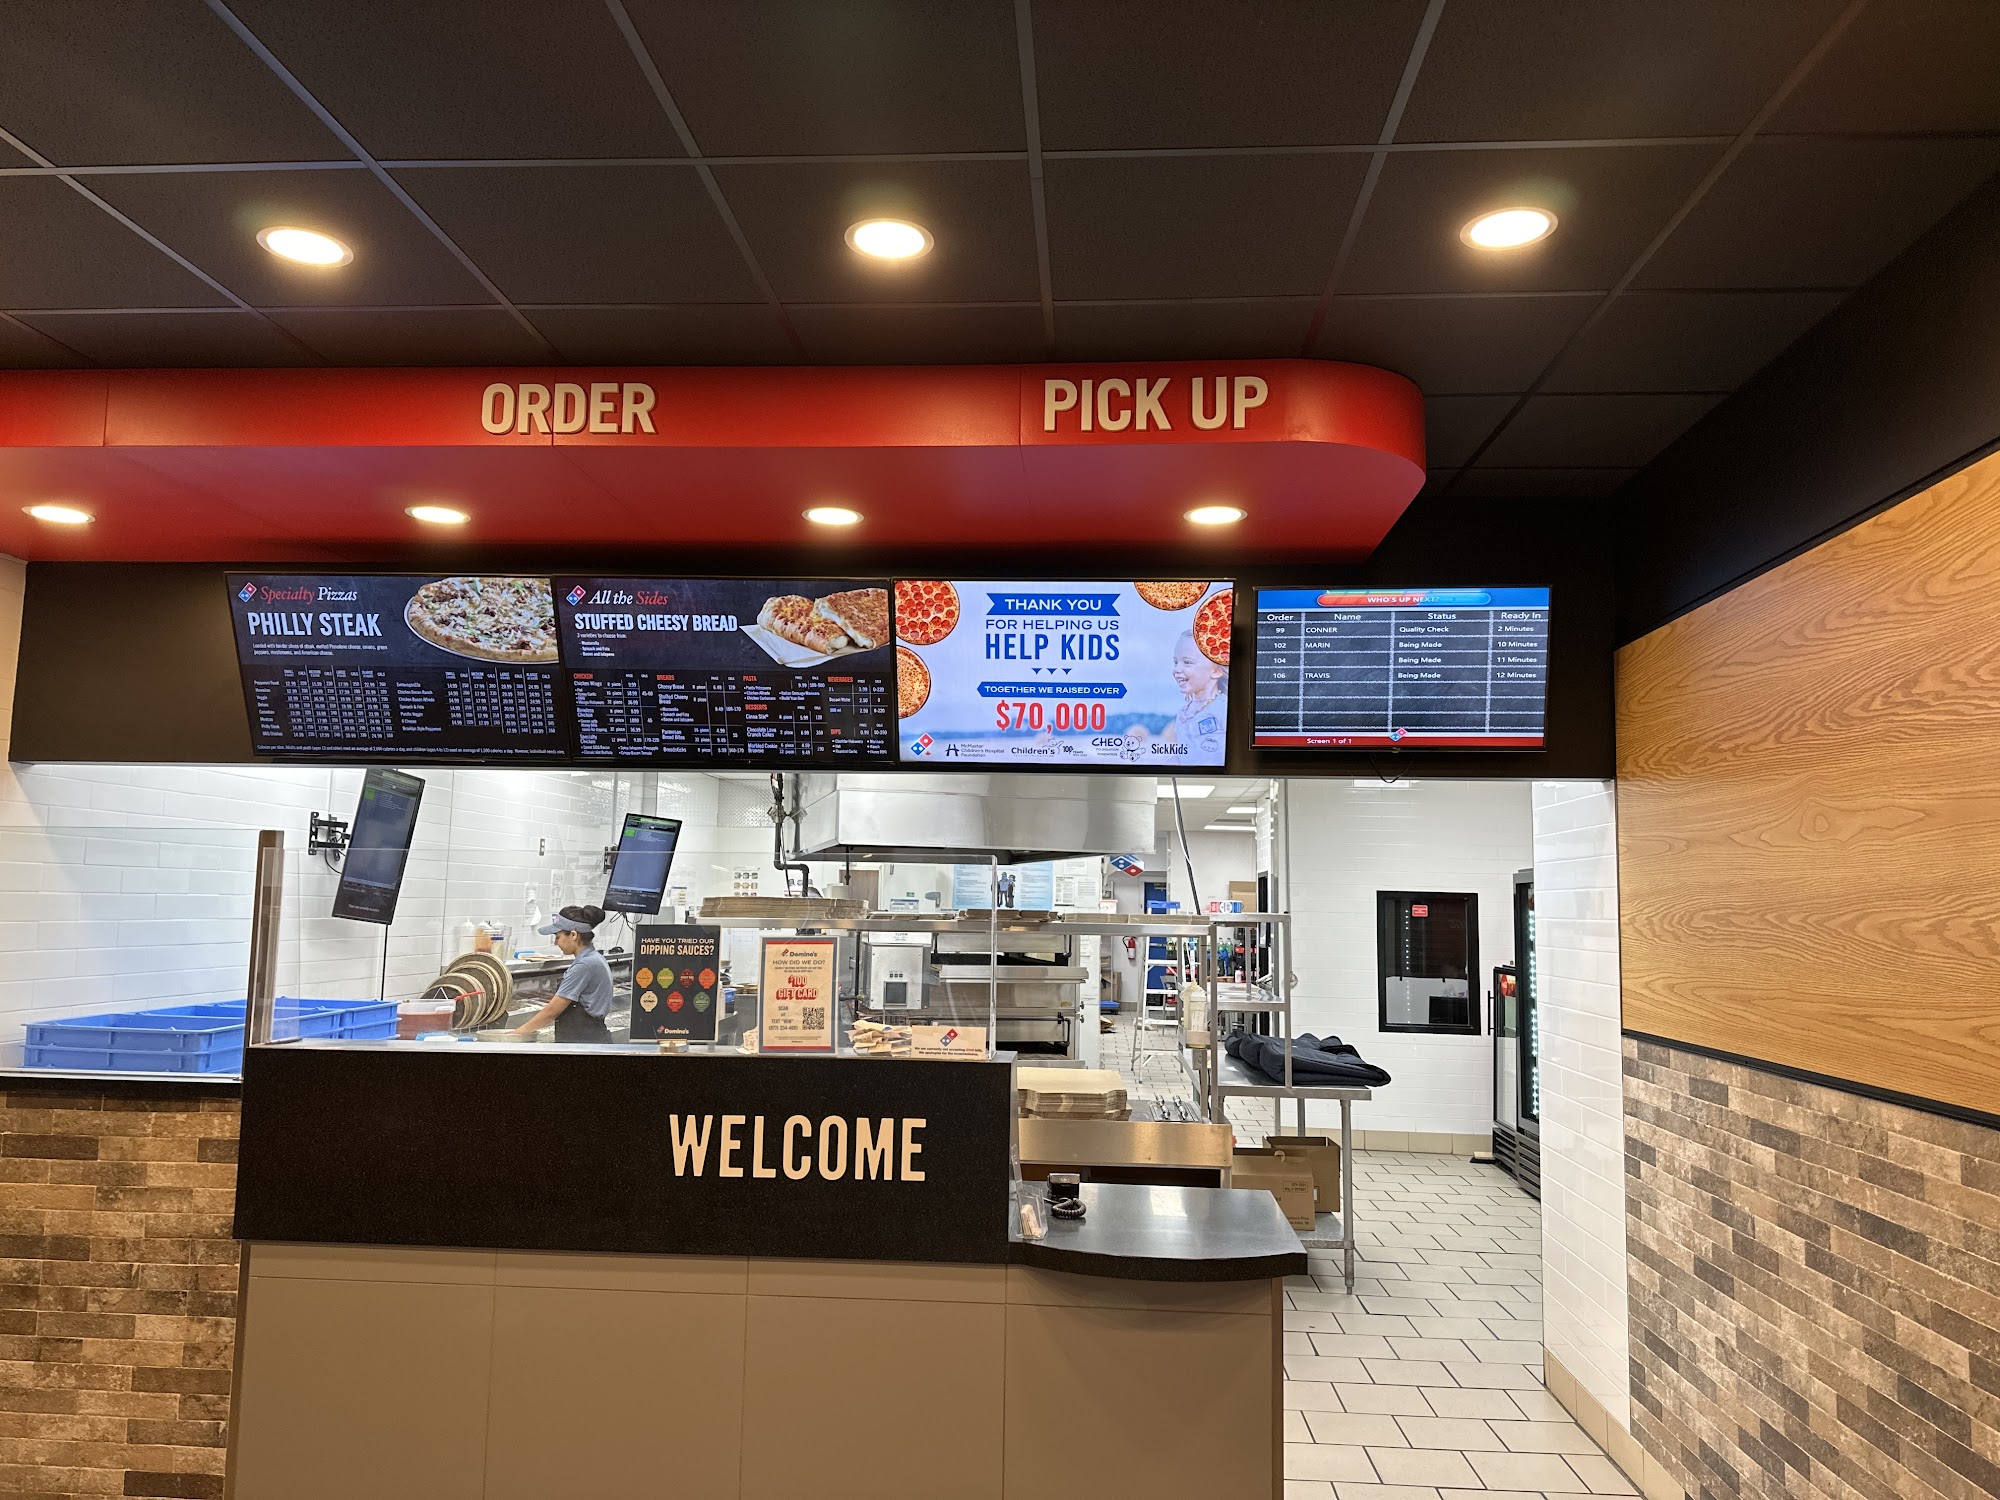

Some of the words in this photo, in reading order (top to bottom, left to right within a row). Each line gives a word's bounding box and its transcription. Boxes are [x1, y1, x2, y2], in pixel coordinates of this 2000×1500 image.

[479, 382, 657, 435] ORDER
[1043, 377, 1173, 432] PICK
[1190, 375, 1268, 429] UP
[260, 586, 314, 604] Specialty
[318, 587, 357, 600] Pizzas
[588, 591, 610, 604] All
[613, 591, 633, 605] the
[636, 591, 668, 605] Sides
[1005, 599, 1061, 611] THANK
[1066, 599, 1102, 611] YOU
[575, 613, 633, 631] STUFFED
[637, 613, 690, 632] CHEESY
[693, 615, 738, 632] BREAD
[1428, 612, 1456, 620] Status
[1501, 612, 1527, 621] Ready
[248, 613, 313, 636] PHILLY
[319, 614, 382, 636] STEAK
[985, 619, 1017, 630] FOR
[1023, 619, 1093, 630] HELPING
[1098, 620, 1119, 630] US
[1399, 626, 1424, 634] Quality
[985, 634, 1049, 660] HELP
[1061, 634, 1119, 661] KIDS
[1398, 672, 1417, 680] Being
[984, 686, 1036, 694] TOGETHER
[1038, 686, 1053, 695] WE
[1056, 686, 1091, 695] RAISED
[1093, 687, 1119, 695] OVER
[996, 700, 1106, 734] $70,000
[1092, 738, 1122, 746] CHEO
[1011, 747, 1055, 755] Children's
[1151, 744, 1188, 754] SickKids
[641, 945, 675, 955] DIPPING
[677, 945, 714, 955] SAUCES?
[788, 975, 807, 987] $100
[776, 988, 795, 1000] GIFT
[795, 988, 818, 1000] CARD
[670, 1114, 926, 1181] WELCOME
